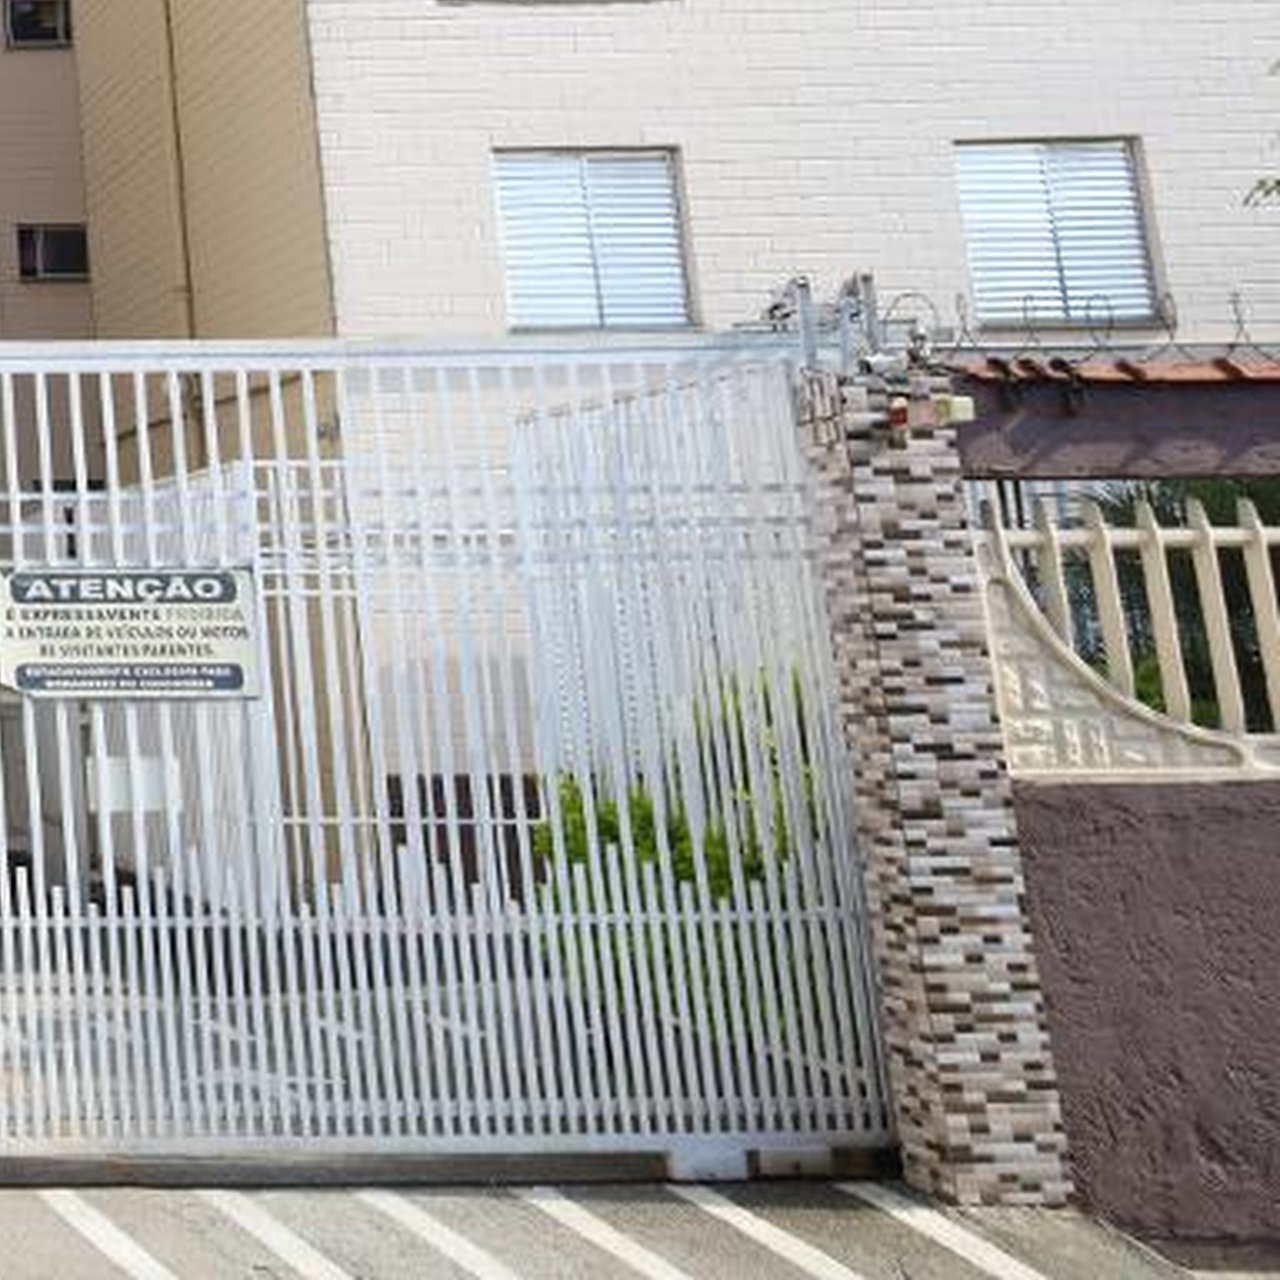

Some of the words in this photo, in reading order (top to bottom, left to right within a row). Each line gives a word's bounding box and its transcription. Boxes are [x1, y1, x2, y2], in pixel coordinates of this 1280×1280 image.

[24, 575, 223, 602] ATENÇÃO
[19, 625, 81, 638] ENTRADA
[176, 625, 197, 639] OU
